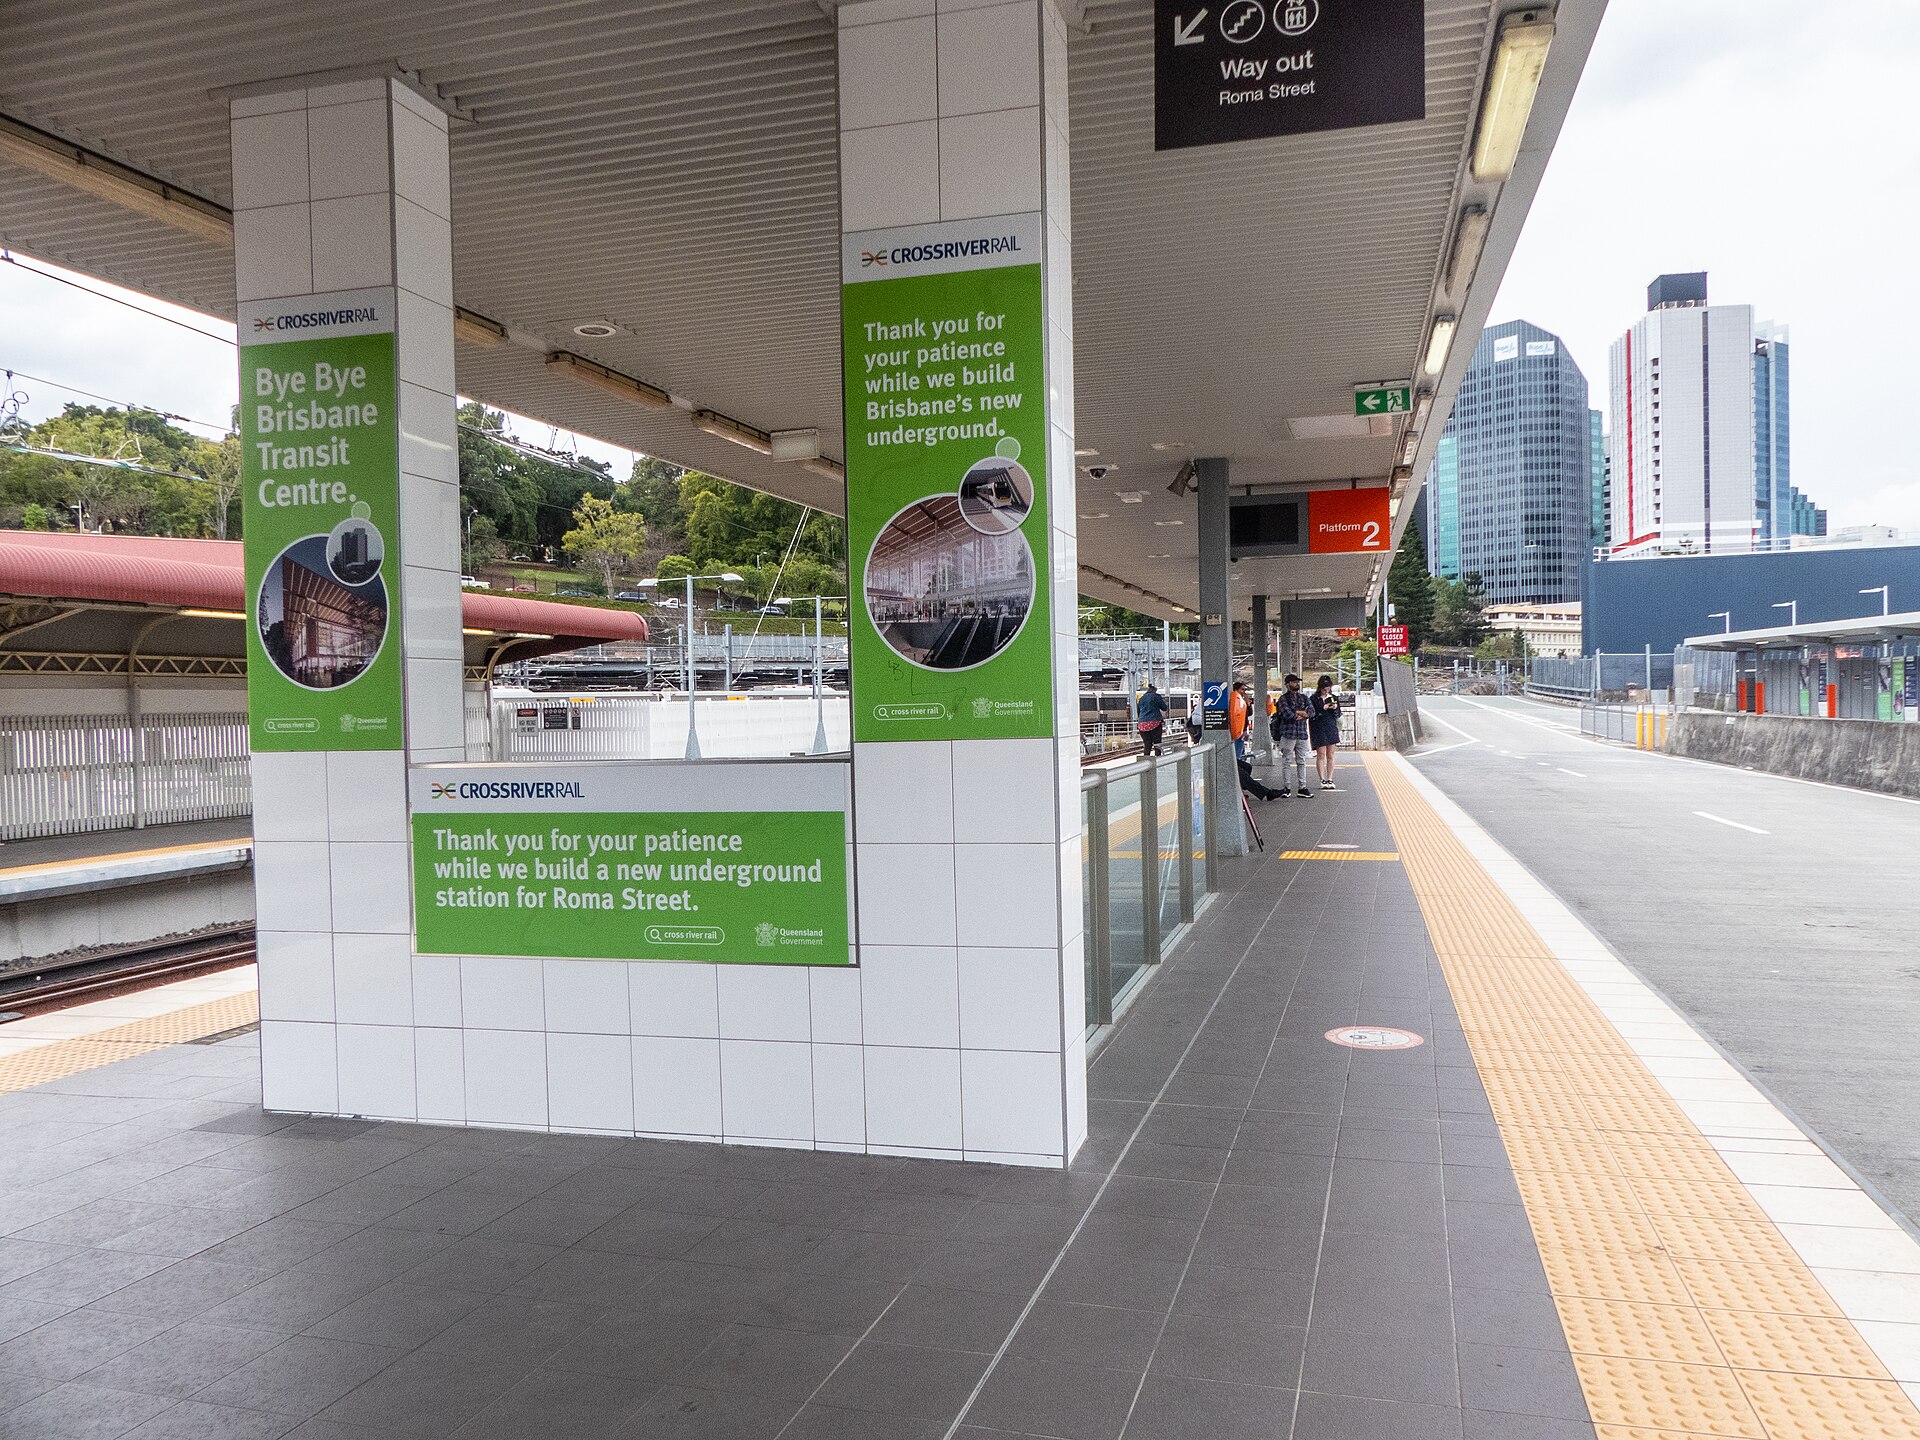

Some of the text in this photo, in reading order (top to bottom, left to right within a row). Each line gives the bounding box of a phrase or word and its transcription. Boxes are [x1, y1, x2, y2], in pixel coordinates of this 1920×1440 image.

[1220, 50, 1313, 80] Way out
[1220, 80, 1316, 105] Roma Street
[864, 311, 1005, 342] Thank you for
[865, 341, 1005, 372] your patience
[256, 363, 365, 401] Bye Bye
[865, 362, 1014, 394] while we build
[979, 393, 1022, 410] new
[258, 400, 377, 433] Brisbane
[867, 417, 1005, 446] underground.
[257, 436, 350, 470] Transit
[259, 478, 356, 507] Centre.
[1319, 521, 1380, 546] Platform 2
[927, 706, 938, 714] rail
[995, 700, 1033, 708] Queensland
[995, 708, 1033, 716] Government
[434, 829, 742, 857] Thank you for your patience
[434, 857, 821, 887] while we build a new underground
[436, 886, 699, 911] station for Roma Street.
[664, 929, 717, 940] cross river rail
[779, 927, 823, 937] Queensland
[779, 936, 823, 945] Government
